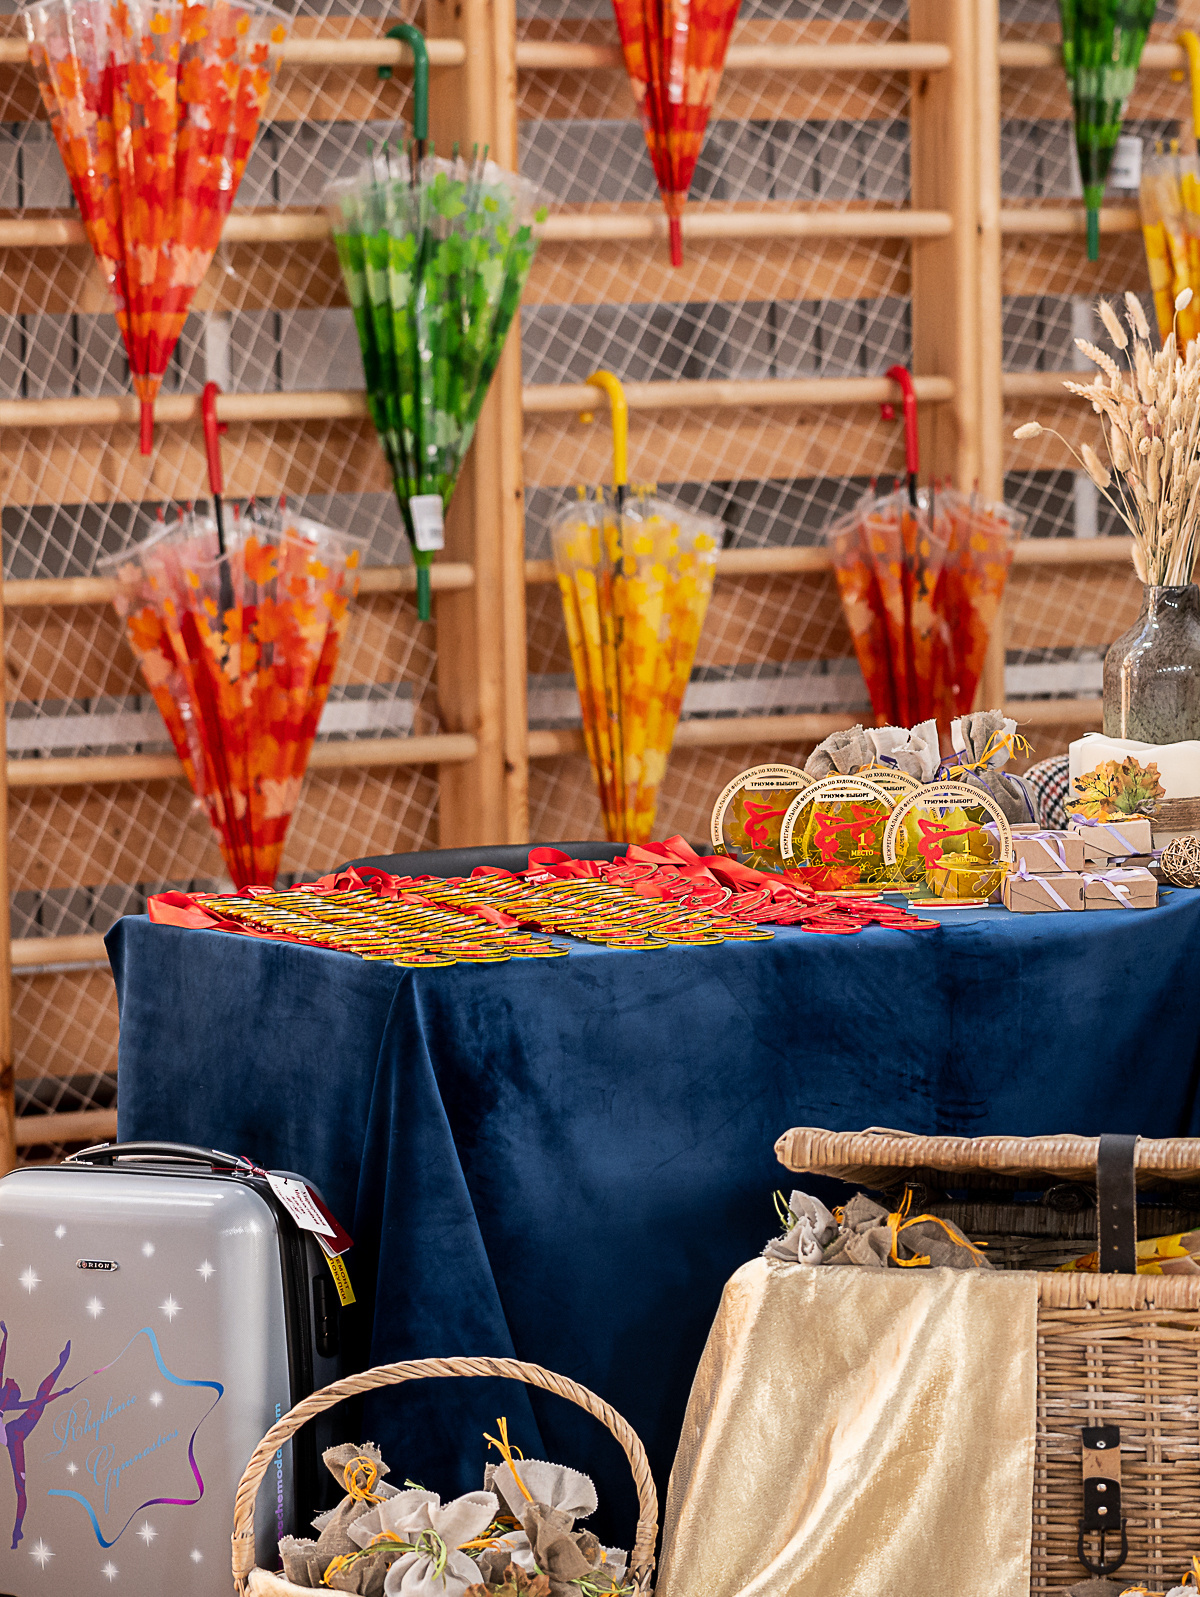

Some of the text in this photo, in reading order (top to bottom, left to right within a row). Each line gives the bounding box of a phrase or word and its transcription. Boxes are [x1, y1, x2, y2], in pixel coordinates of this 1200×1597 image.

[713, 789, 731, 842] МЕЖРЕГИОНАЛЬНЫЙ
[731, 771, 757, 790] ФЕСТИВАЛЬ
[766, 767, 812, 784] ХУДОЖЕСТВЕННОЙ
[873, 772, 919, 790] ХУДОЖЕСТВЕННОЙ
[784, 800, 801, 855] МЕЖРЕГИОНАЛЬНЫЙ
[800, 783, 827, 802] ФЕСТИВАЛЬ
[836, 779, 882, 796] ХУДОЖЕСТВЕННОЙ
[858, 833, 867, 845] 1
[887, 807, 904, 861] МЕЖРЕГИОНАЛЬНЫЙ
[903, 789, 930, 807] ФЕСТИВАЛЬ
[940, 785, 986, 801] ХУДОЖЕСТВЕННОЙ
[986, 800, 1008, 831] ГИМНАСТИКЕ
[962, 840, 971, 853] 1
[329, 1258, 347, 1300] ПОКУПКИ
[335, 1255, 350, 1290] ЕМОНТ
[42, 1394, 137, 1463] Rhythmic
[85, 1428, 179, 1514] Gymnastics
